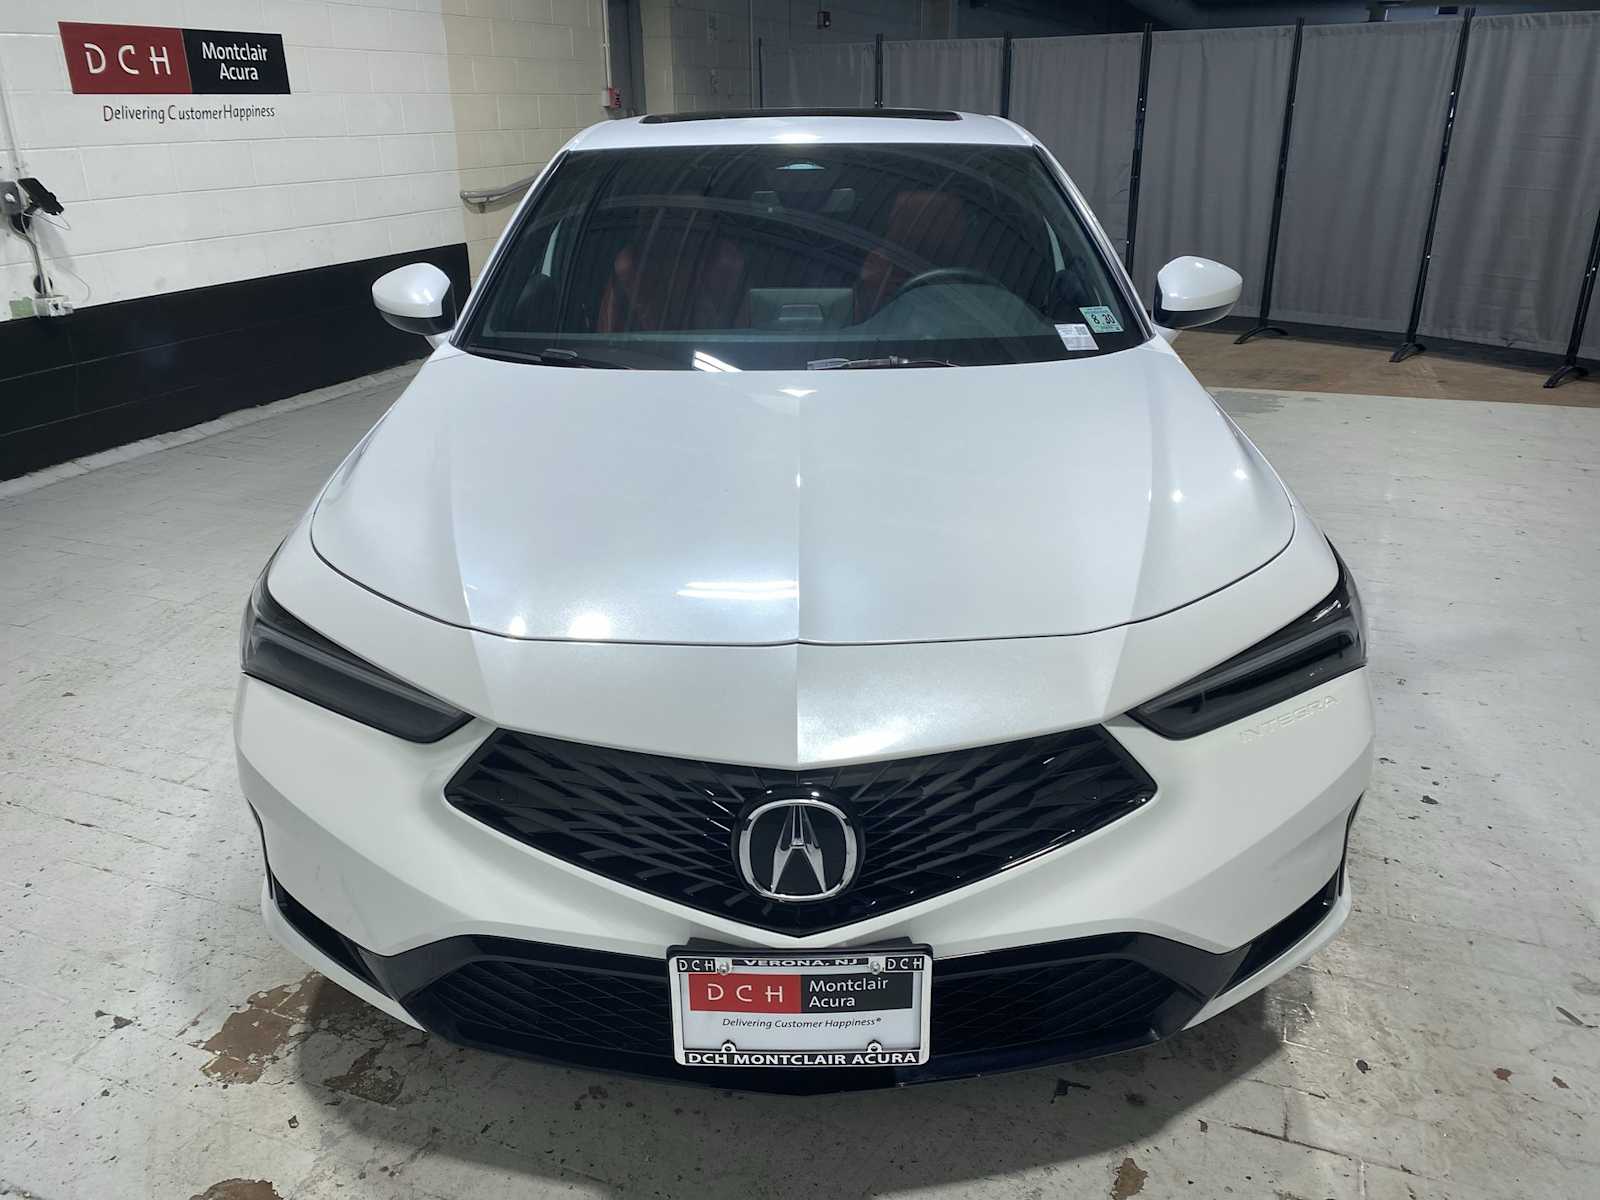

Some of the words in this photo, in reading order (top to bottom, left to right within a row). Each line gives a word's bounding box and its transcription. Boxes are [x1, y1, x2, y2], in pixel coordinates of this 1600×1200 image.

[202, 41, 268, 63] Montclair
[219, 63, 259, 81] Acura
[102, 105, 165, 124] Delivering
[1239, 695, 1338, 745] INTEGRA
[835, 958, 858, 966] NJ
[809, 977, 888, 993] Montclair
[809, 995, 855, 1008] Acura
[722, 1017, 772, 1030] Delivering
[775, 1018, 822, 1029] Customer
[688, 1052, 728, 1065] DCH
[733, 1053, 847, 1065] MONTCLAIR
[852, 1053, 917, 1064] ACURA
